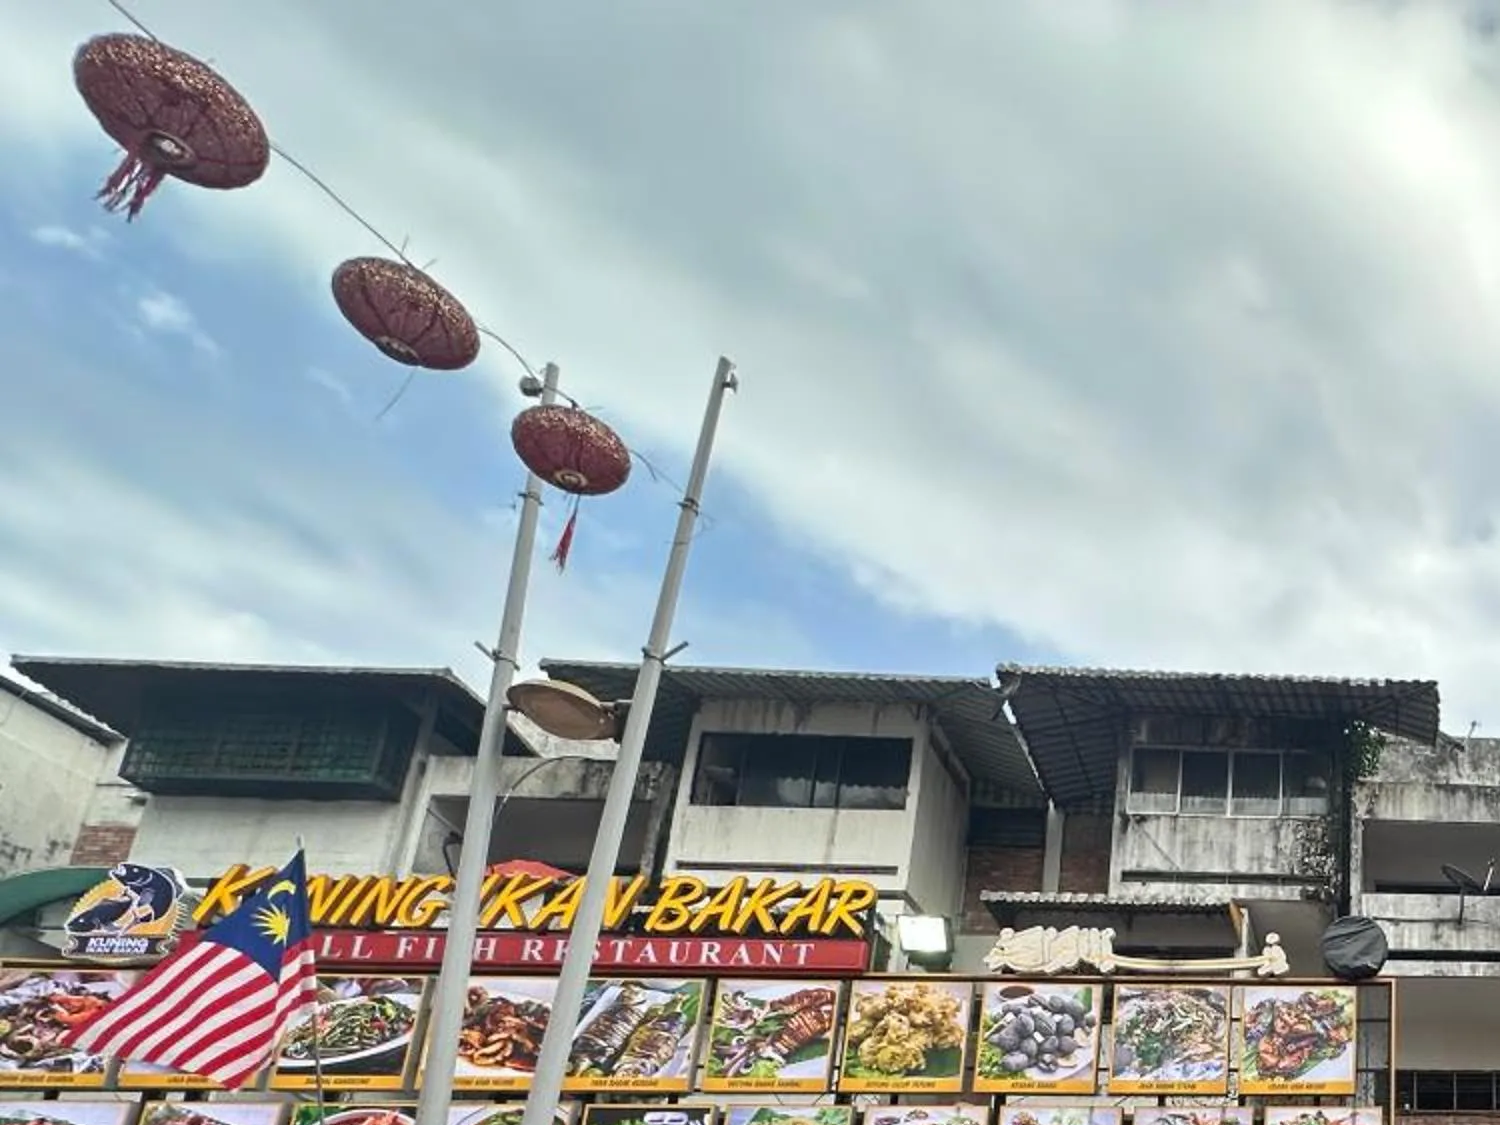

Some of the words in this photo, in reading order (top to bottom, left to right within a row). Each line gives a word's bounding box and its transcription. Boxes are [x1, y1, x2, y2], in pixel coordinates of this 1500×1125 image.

[190, 863, 456, 927] KNING
[646, 876, 877, 937] BAKAR
[87, 937, 149, 949] KUNING
[399, 936, 498, 961] FIH
